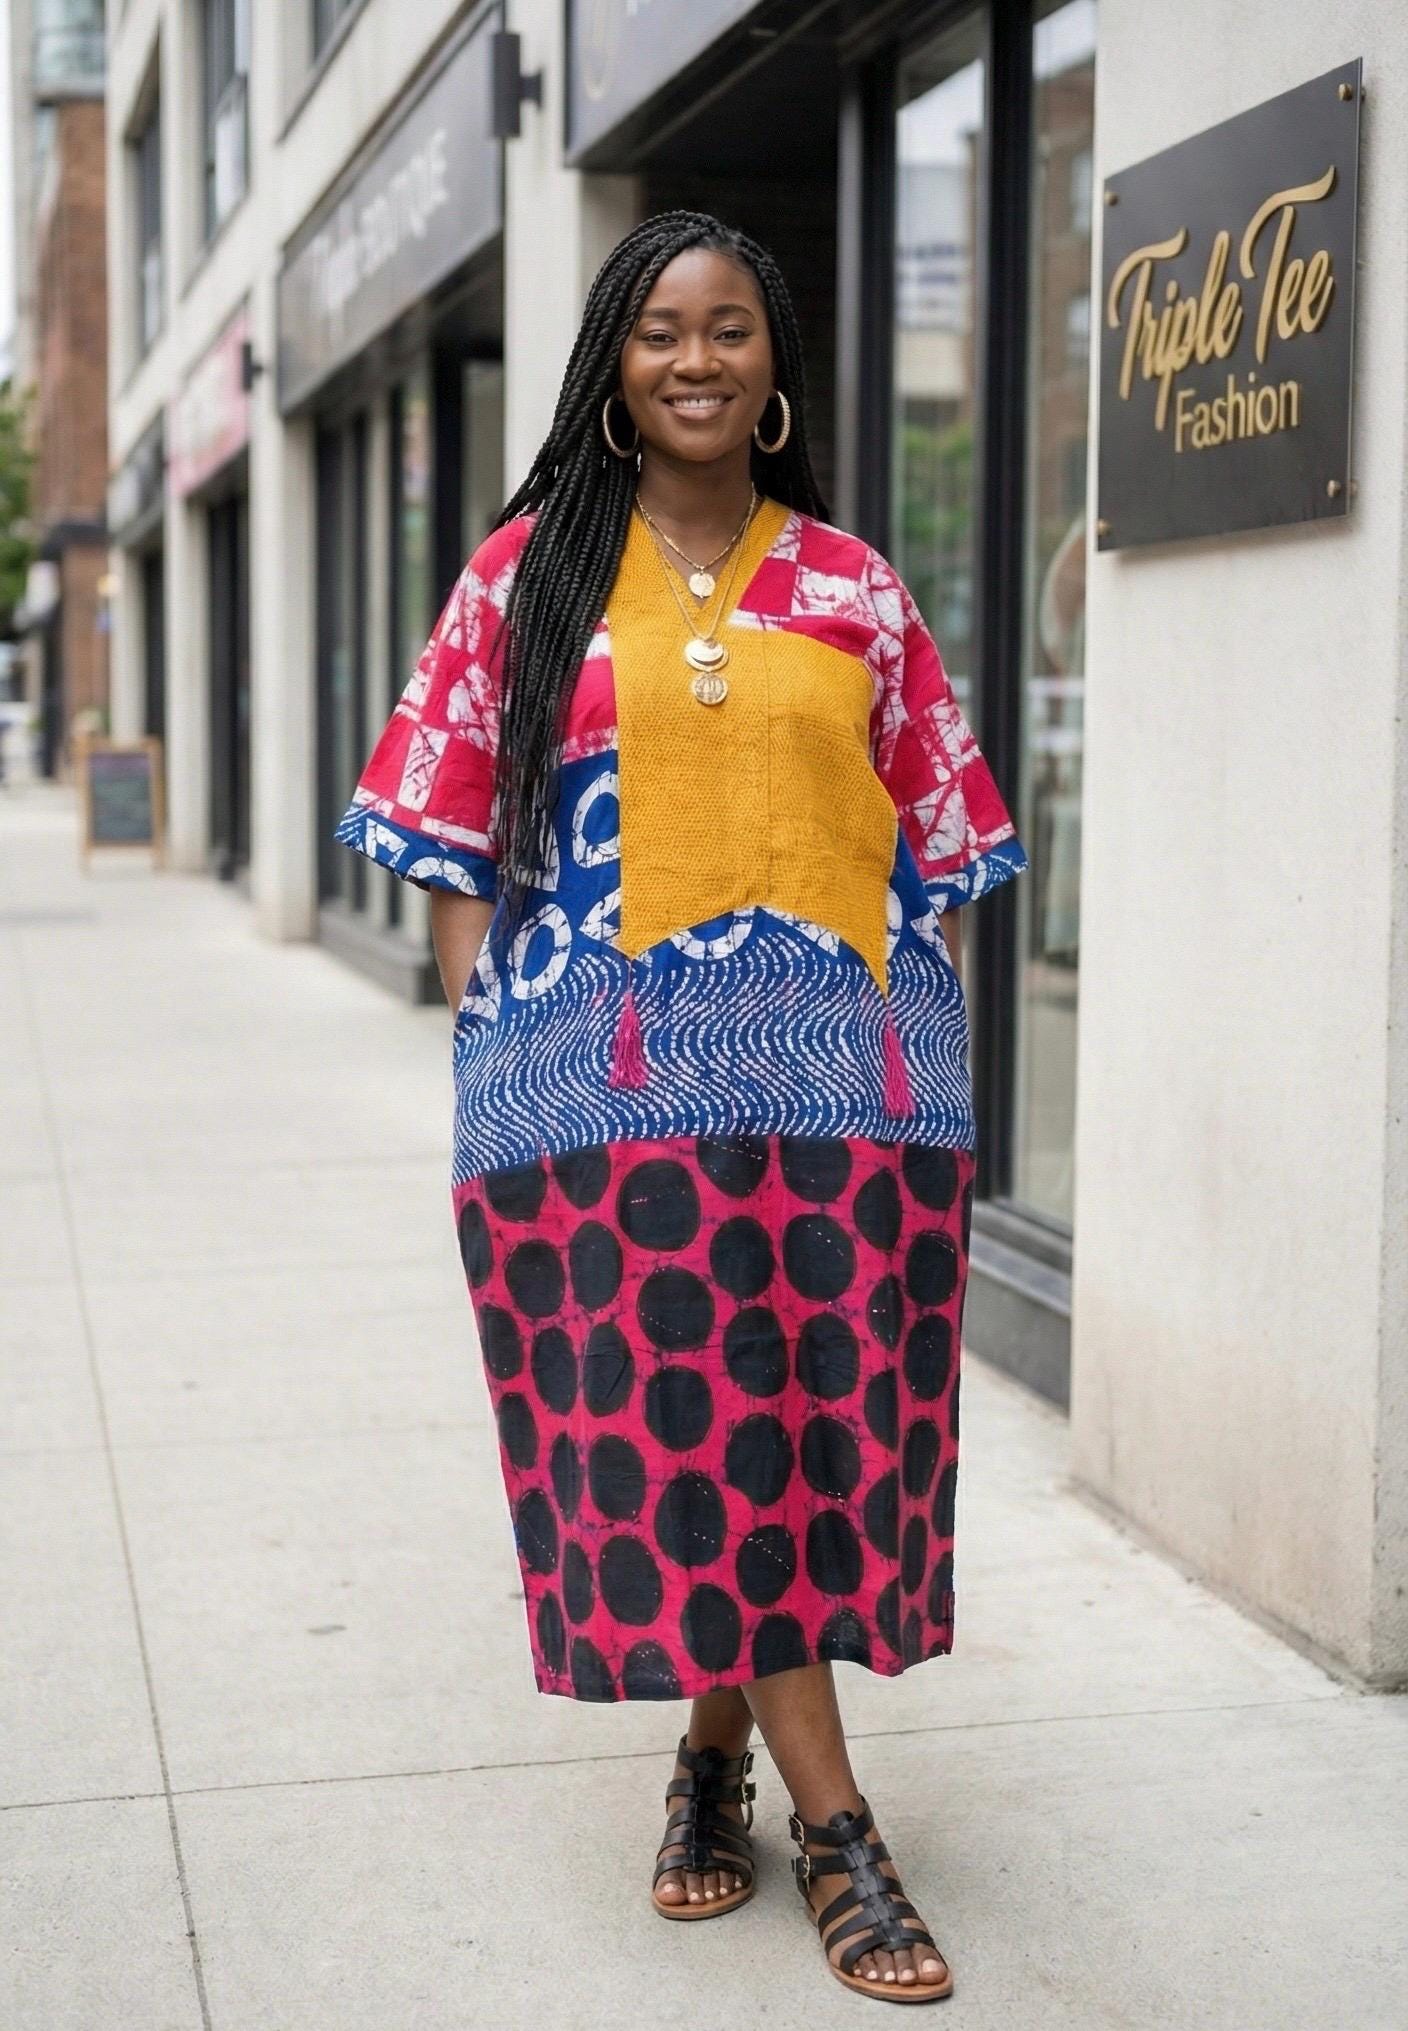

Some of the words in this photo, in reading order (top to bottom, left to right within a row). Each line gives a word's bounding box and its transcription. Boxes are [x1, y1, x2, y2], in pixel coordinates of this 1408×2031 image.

[1109, 228, 1241, 430] Triple
[1241, 165, 1335, 363] Tee
[1175, 372, 1299, 452] Fashion
